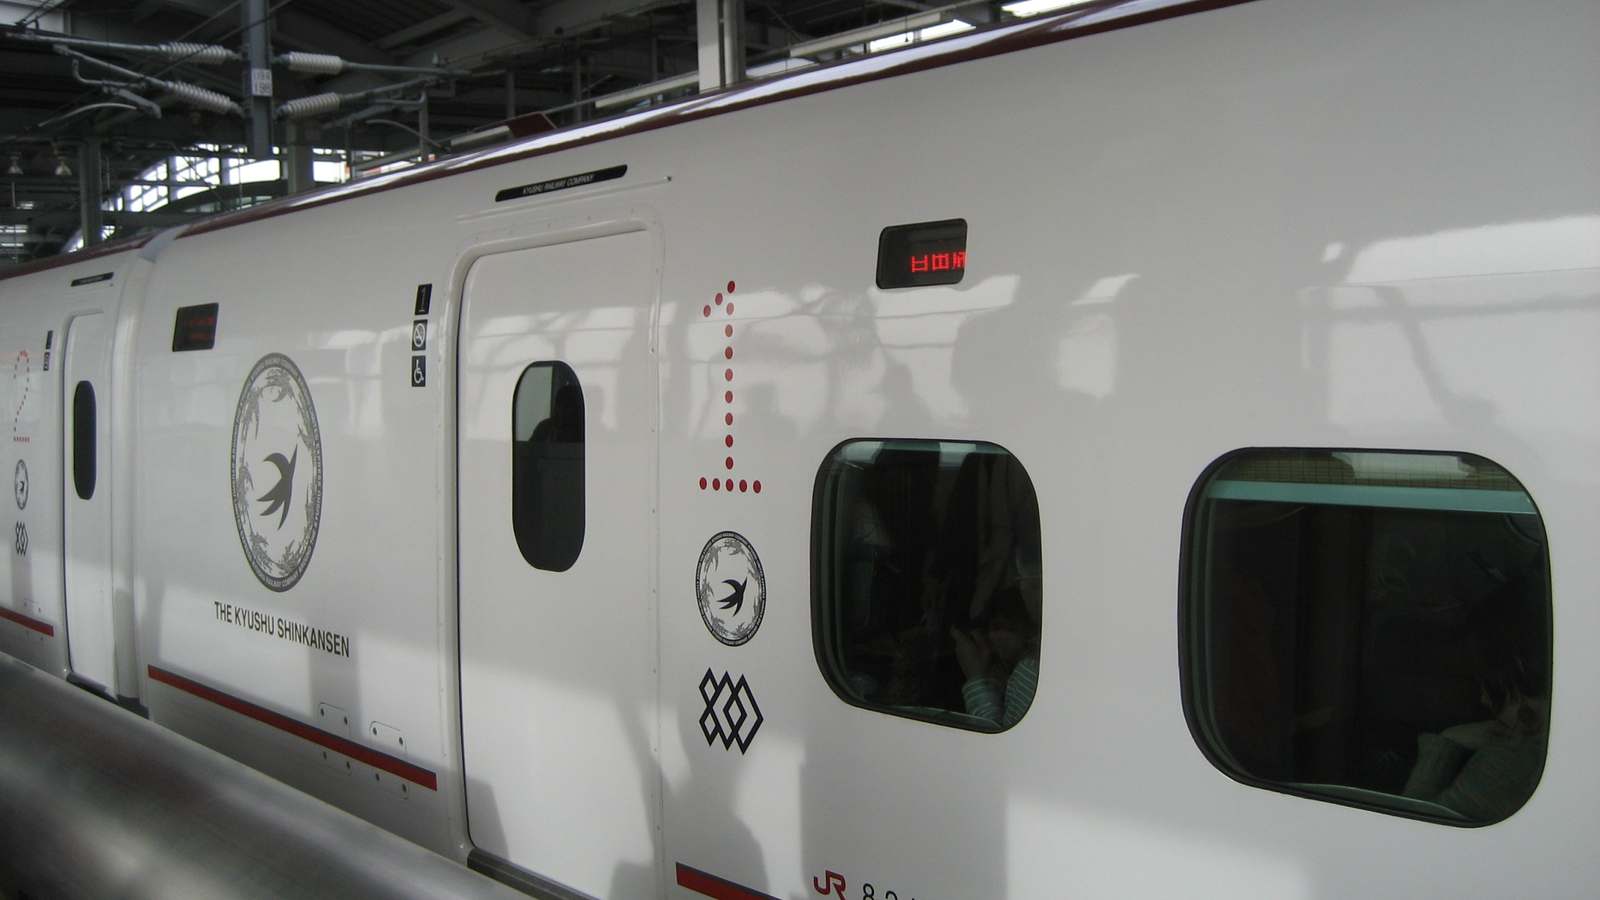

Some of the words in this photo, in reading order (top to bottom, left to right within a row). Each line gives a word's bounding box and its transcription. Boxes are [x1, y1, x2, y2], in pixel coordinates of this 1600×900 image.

[522, 184, 544, 195] KYUSHU
[543, 180, 567, 191] RAILWAY
[566, 174, 595, 186] COMPANY
[699, 280, 762, 494] 1
[214, 600, 232, 623] THE
[234, 605, 275, 635] KYUSHU
[277, 617, 350, 658] SHINKANSEN
[813, 869, 846, 900] JR
